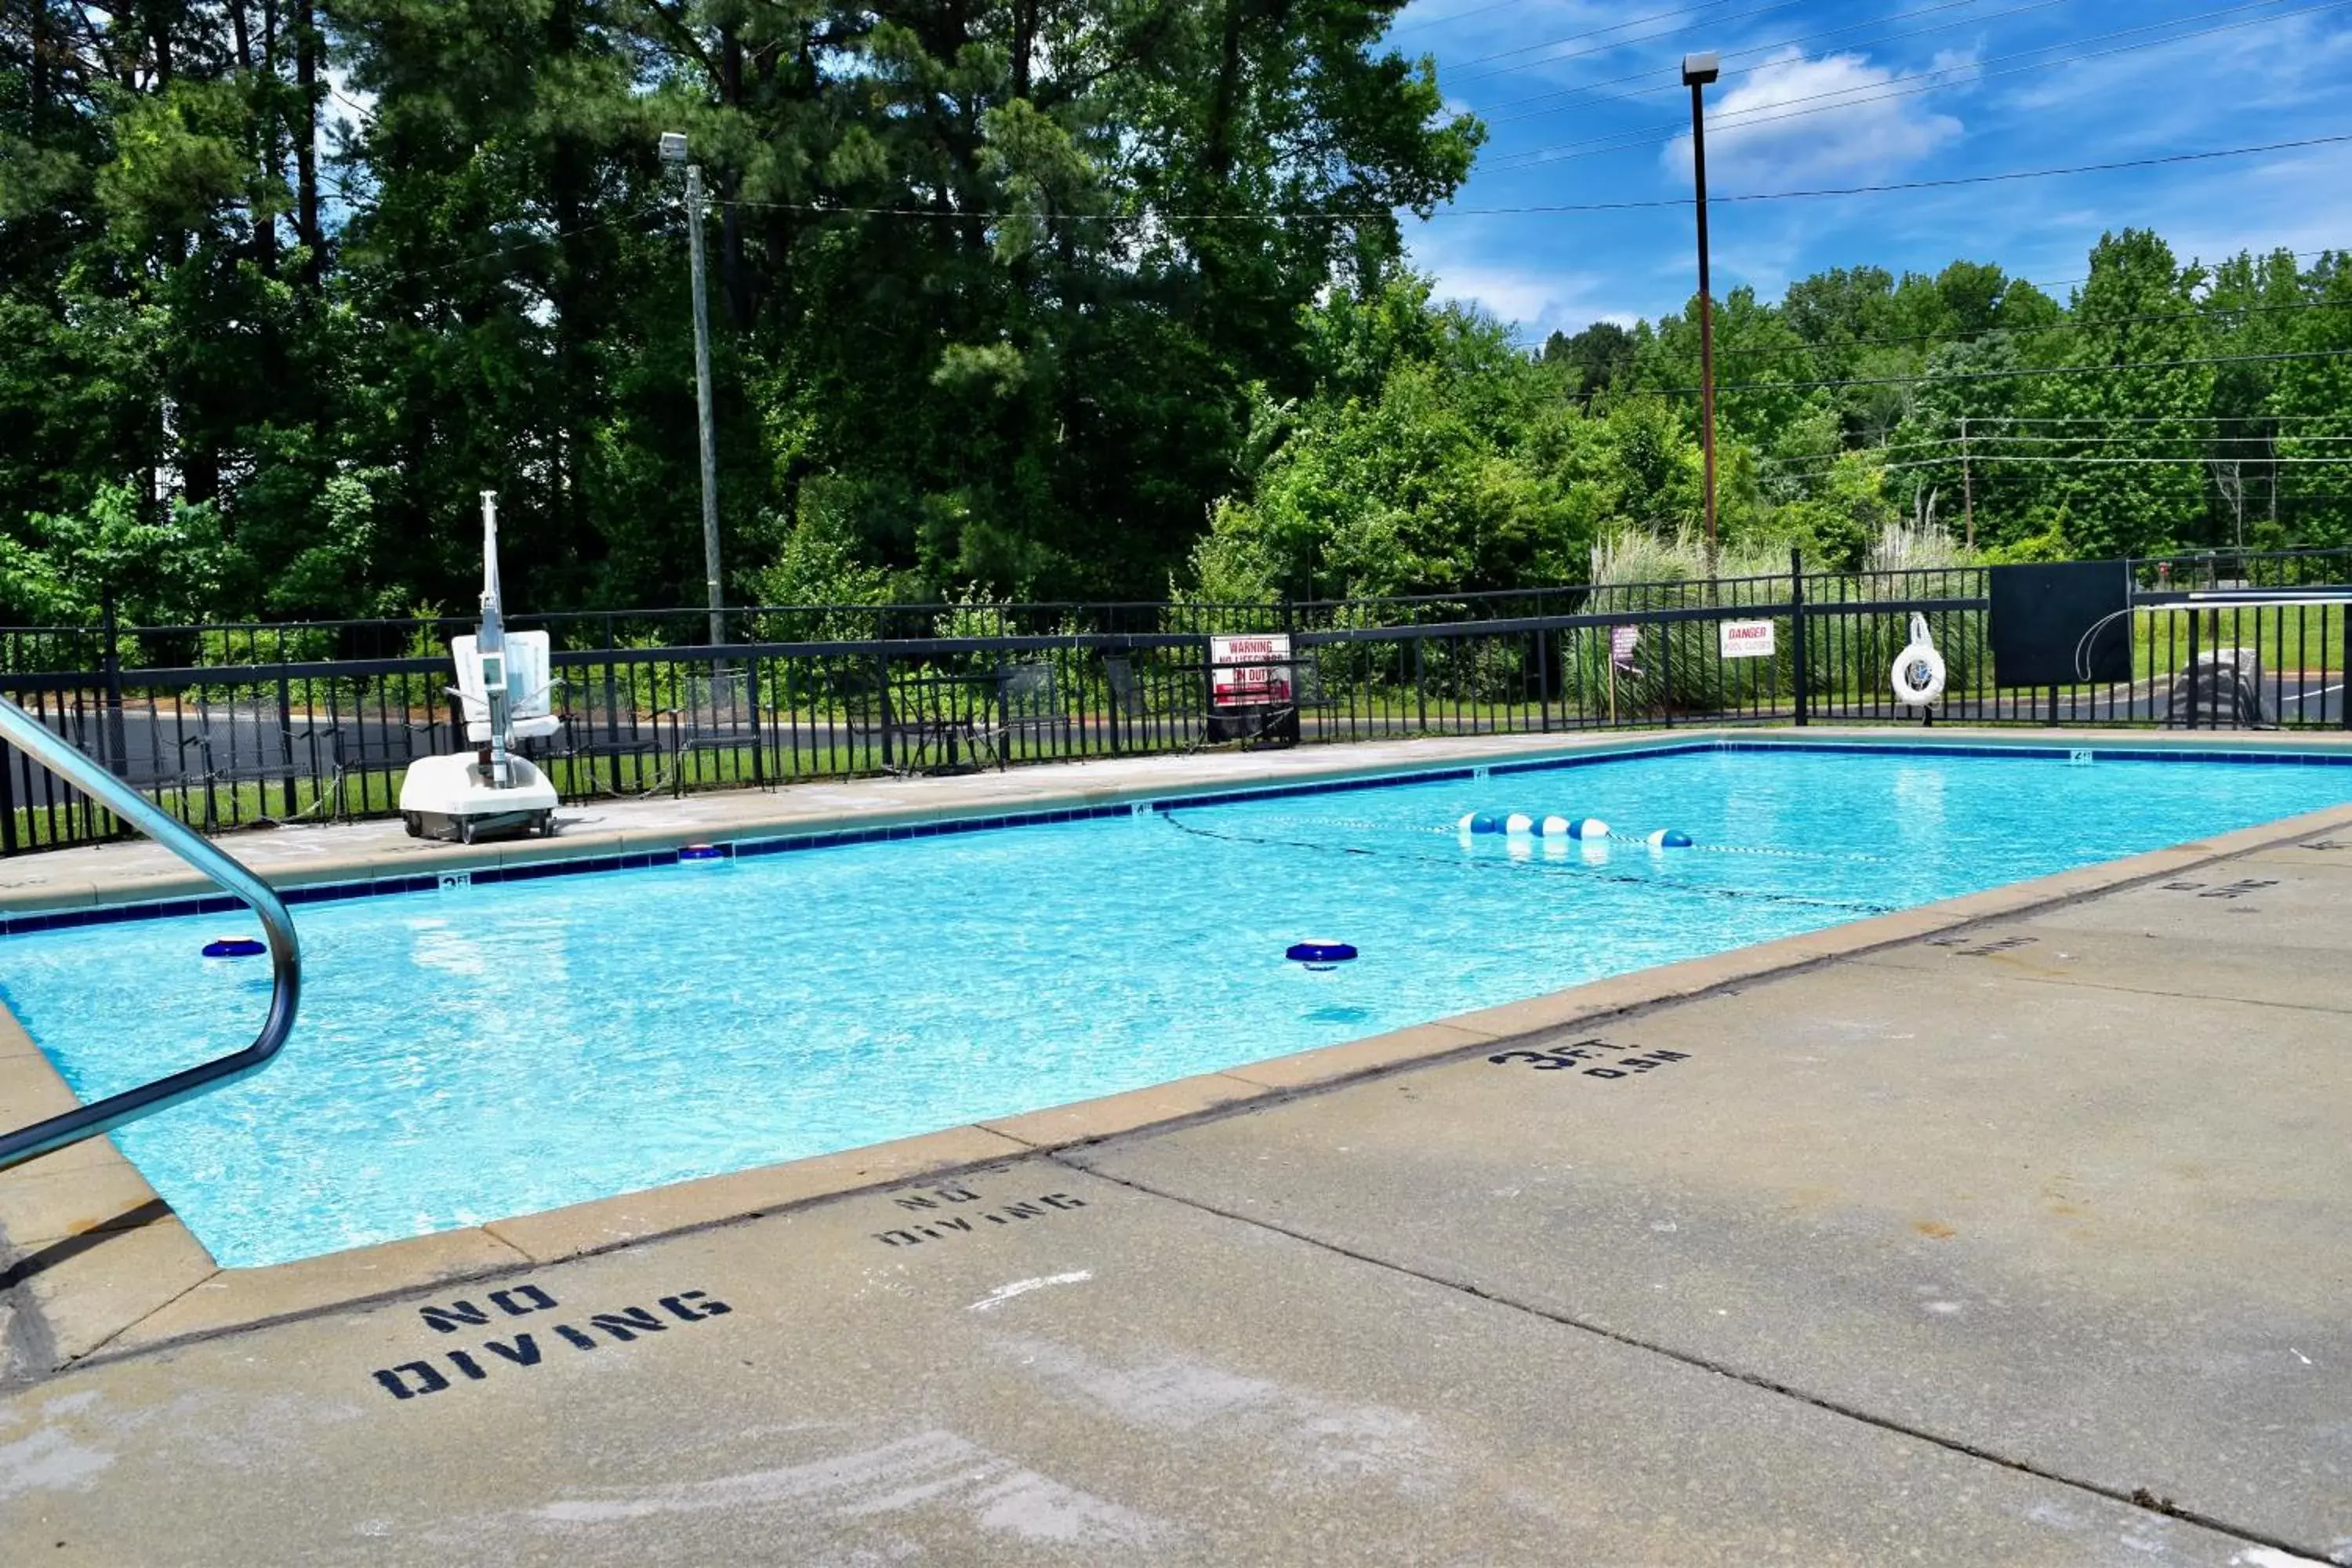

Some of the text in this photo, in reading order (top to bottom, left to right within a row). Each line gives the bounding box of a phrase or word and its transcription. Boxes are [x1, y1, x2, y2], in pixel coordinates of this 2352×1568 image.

[1229, 641, 1272, 653] WARNING
[1728, 626, 1766, 640] DANGER
[419, 1284, 558, 1333] NO
[372, 1290, 732, 1400] DIVING
